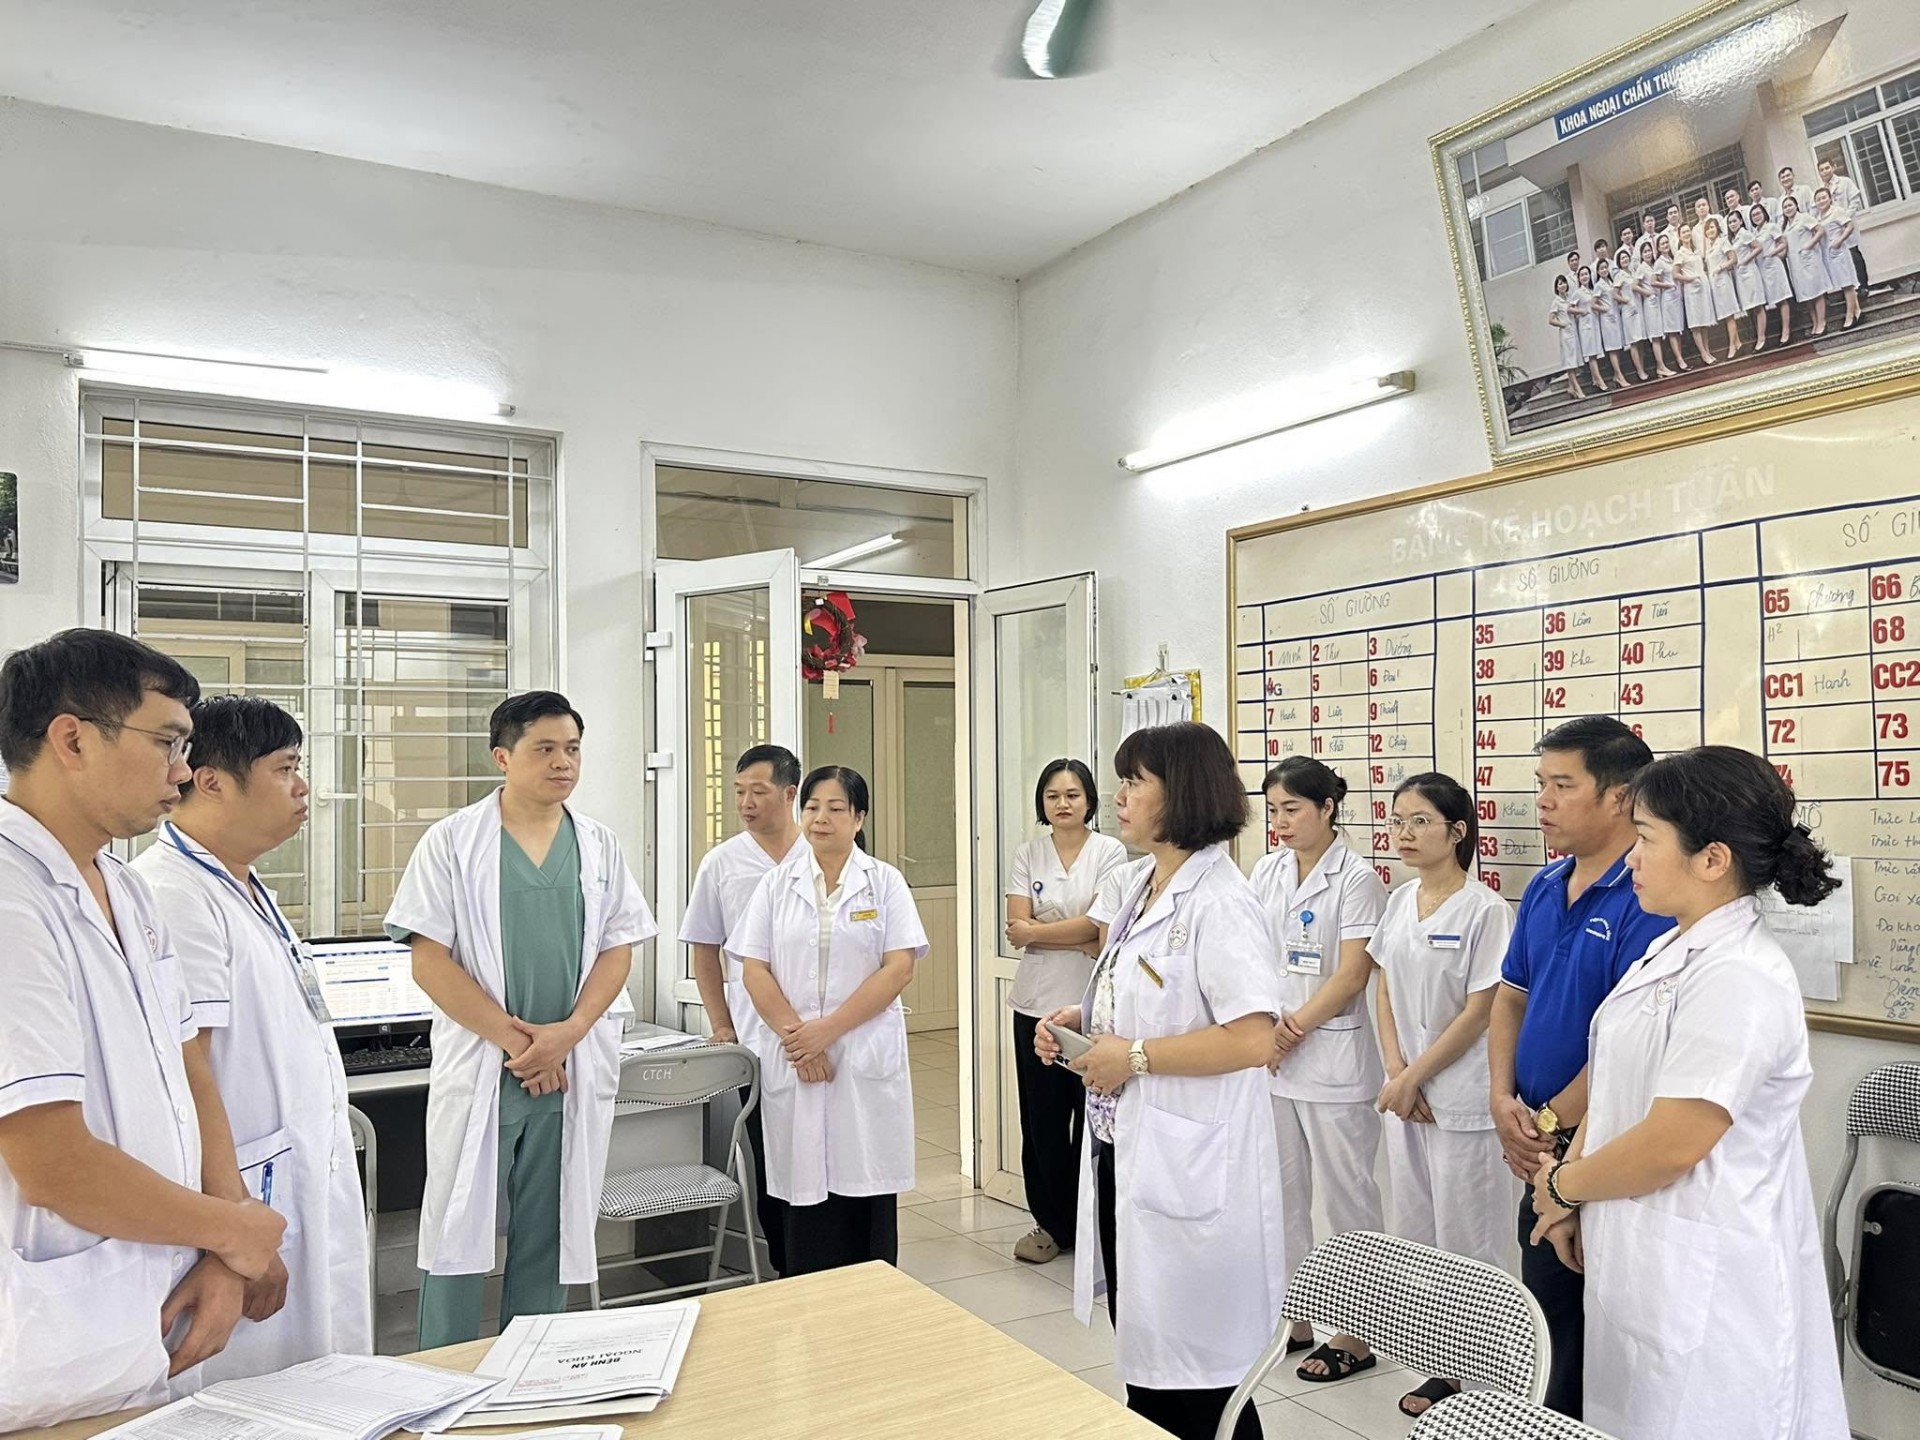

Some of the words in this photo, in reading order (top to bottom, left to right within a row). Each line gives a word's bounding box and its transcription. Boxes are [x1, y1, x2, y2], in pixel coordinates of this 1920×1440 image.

[1560, 110, 1588, 134] KHOA
[1588, 94, 1621, 115] NGOẠI
[1622, 76, 1652, 106] CHẤN
[1843, 510, 1880, 547] SỐ
[1891, 508, 1920, 537] GI
[1518, 564, 1540, 591] SỐ
[1871, 573, 1902, 601] 66
[1320, 596, 1339, 624] SỐ
[1764, 588, 1790, 613] 65
[1545, 611, 1566, 634] 36
[1620, 604, 1643, 627] 37
[1476, 625, 1494, 644] 35
[1873, 616, 1905, 644] 68
[1312, 644, 1320, 662] 2
[1370, 637, 1377, 655] 3
[1622, 642, 1644, 664] 40
[1267, 650, 1273, 667] 1
[1544, 650, 1565, 672] 39
[1370, 668, 1377, 687] 6
[1476, 659, 1494, 679] 38
[1873, 660, 1920, 690] CC2
[1312, 674, 1320, 691] 5
[1765, 673, 1803, 699] CC1
[1545, 687, 1566, 709] 42
[1621, 683, 1644, 706] 43
[1313, 706, 1319, 723] 8
[1370, 702, 1377, 720] 9
[1476, 695, 1492, 715] 41
[1267, 708, 1274, 725] 7
[1876, 713, 1908, 739] 73
[1477, 730, 1496, 750] 44
[1768, 719, 1795, 744] 72
[1267, 739, 1279, 756] 10
[1312, 736, 1322, 753] 11
[1369, 734, 1382, 752] 12
[1371, 766, 1384, 784] 15
[1477, 766, 1494, 786] 47
[1878, 761, 1910, 787] 75
[1373, 801, 1386, 819] 18
[1478, 800, 1497, 820] 50
[1267, 830, 1279, 846] 19
[1374, 832, 1390, 851] 23
[1479, 836, 1498, 857] 53
[1481, 871, 1501, 892] 56
[643, 1069, 672, 1081] CTCH
